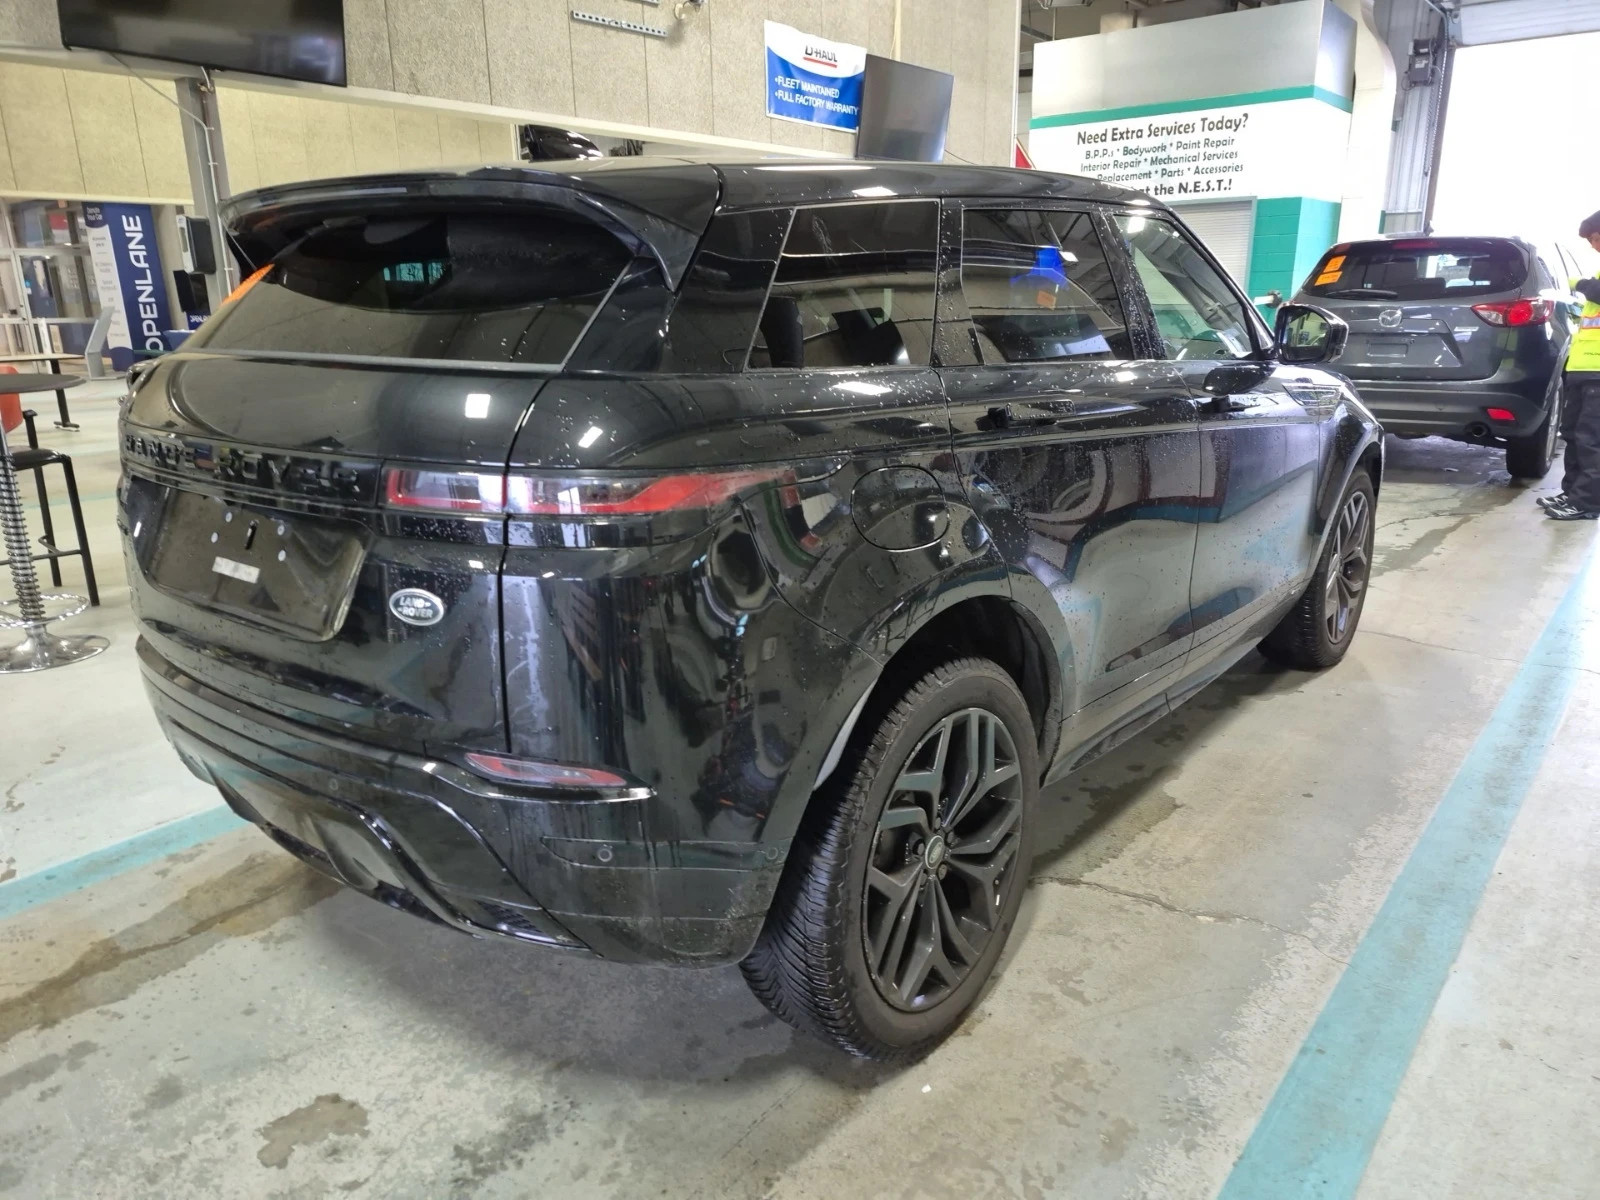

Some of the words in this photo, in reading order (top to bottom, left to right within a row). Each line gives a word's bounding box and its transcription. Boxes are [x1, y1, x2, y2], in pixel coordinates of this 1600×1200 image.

[801, 81, 840, 98] MAINTAINED
[795, 94, 826, 108] FACTORY
[826, 101, 858, 115] WARRANTY
[1077, 128, 1108, 146] Need
[1111, 127, 1144, 142] Extra
[1147, 121, 1196, 138] Services
[1200, 112, 1249, 133] Today?
[1122, 142, 1167, 157] Bodywork
[1176, 139, 1201, 151] Paint
[1203, 136, 1235, 149] Repair
[1080, 163, 1111, 173] Interior
[1112, 158, 1142, 171] Repair
[1150, 152, 1200, 166] Mechanical
[1202, 150, 1238, 162] Services
[1160, 167, 1184, 178] Parts
[1193, 162, 1244, 175] Accessories
[1154, 183, 1175, 196] the
[1178, 178, 1233, 194] N.E.S.T.!
[122, 215, 164, 351] OPENLANE
